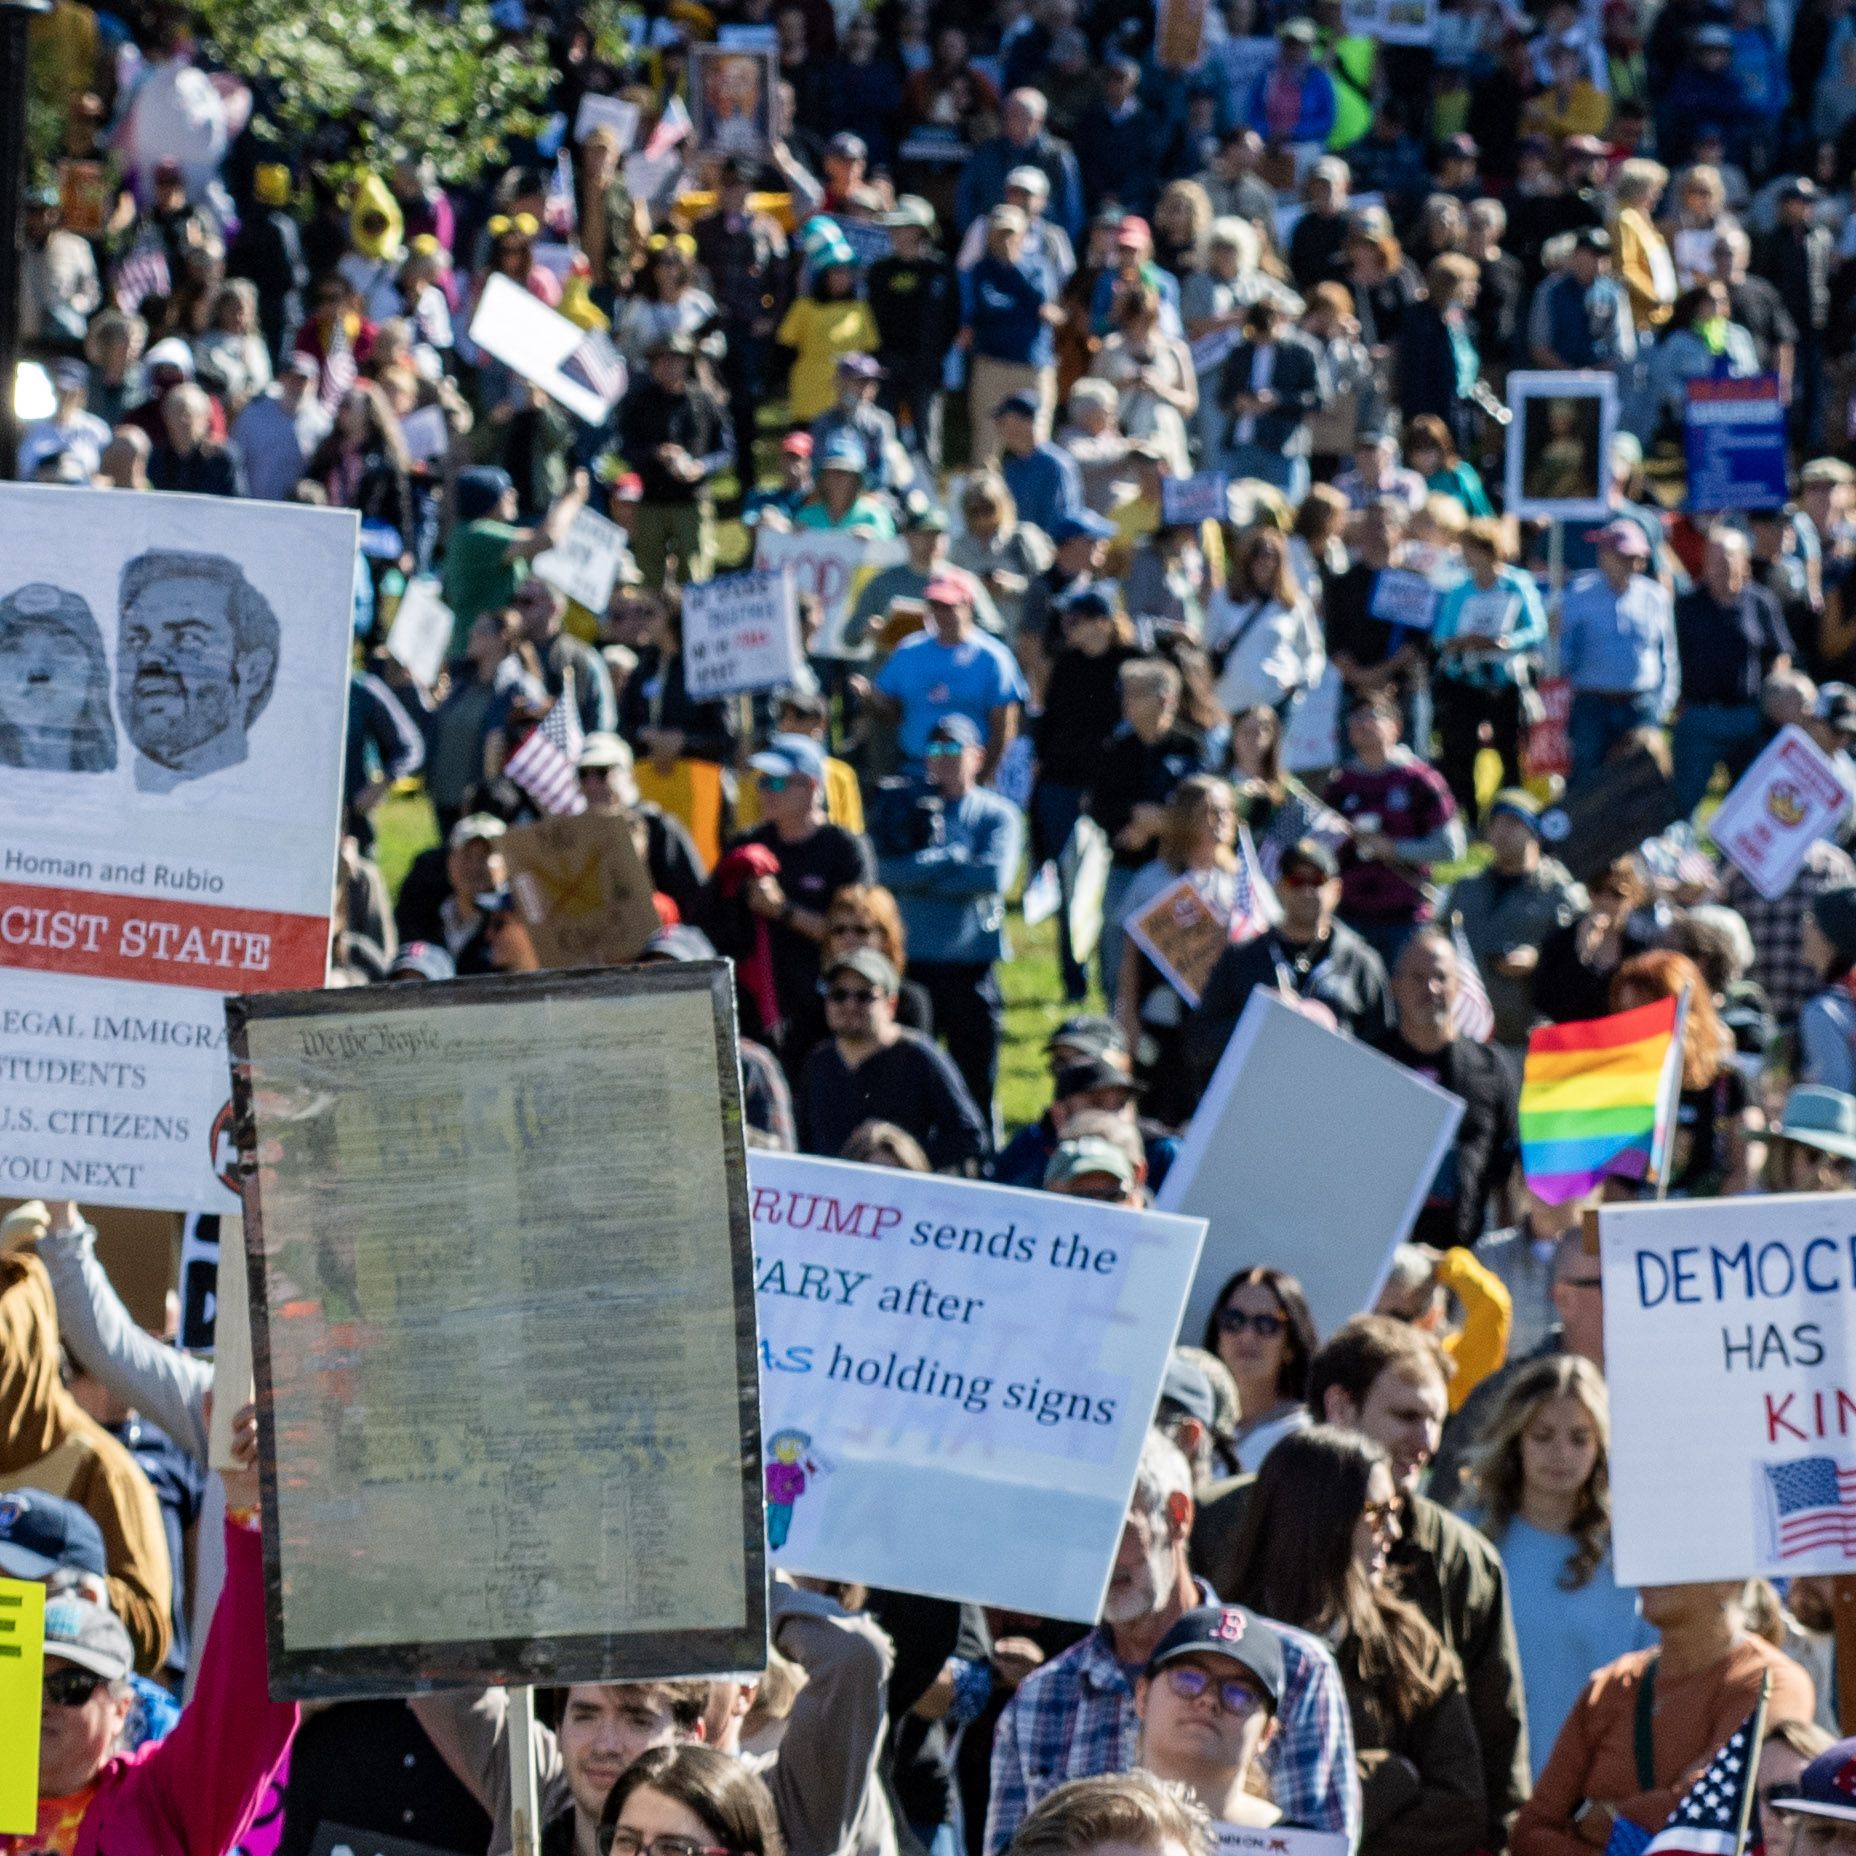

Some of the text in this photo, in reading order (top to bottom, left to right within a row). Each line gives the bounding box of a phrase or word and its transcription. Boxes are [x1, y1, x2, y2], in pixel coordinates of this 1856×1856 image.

[4, 850, 224, 893] Homan and Rubio
[1, 905, 272, 971] CIST STATE
[48, 1110, 189, 1142] CITIZENS
[61, 1160, 144, 1188] NEXT
[909, 1220, 1037, 1264] sends
[1049, 1234, 1118, 1274] the
[878, 1279, 985, 1326] after
[1722, 1323, 1824, 1373] HAS
[827, 1343, 1117, 1428] holding signs
